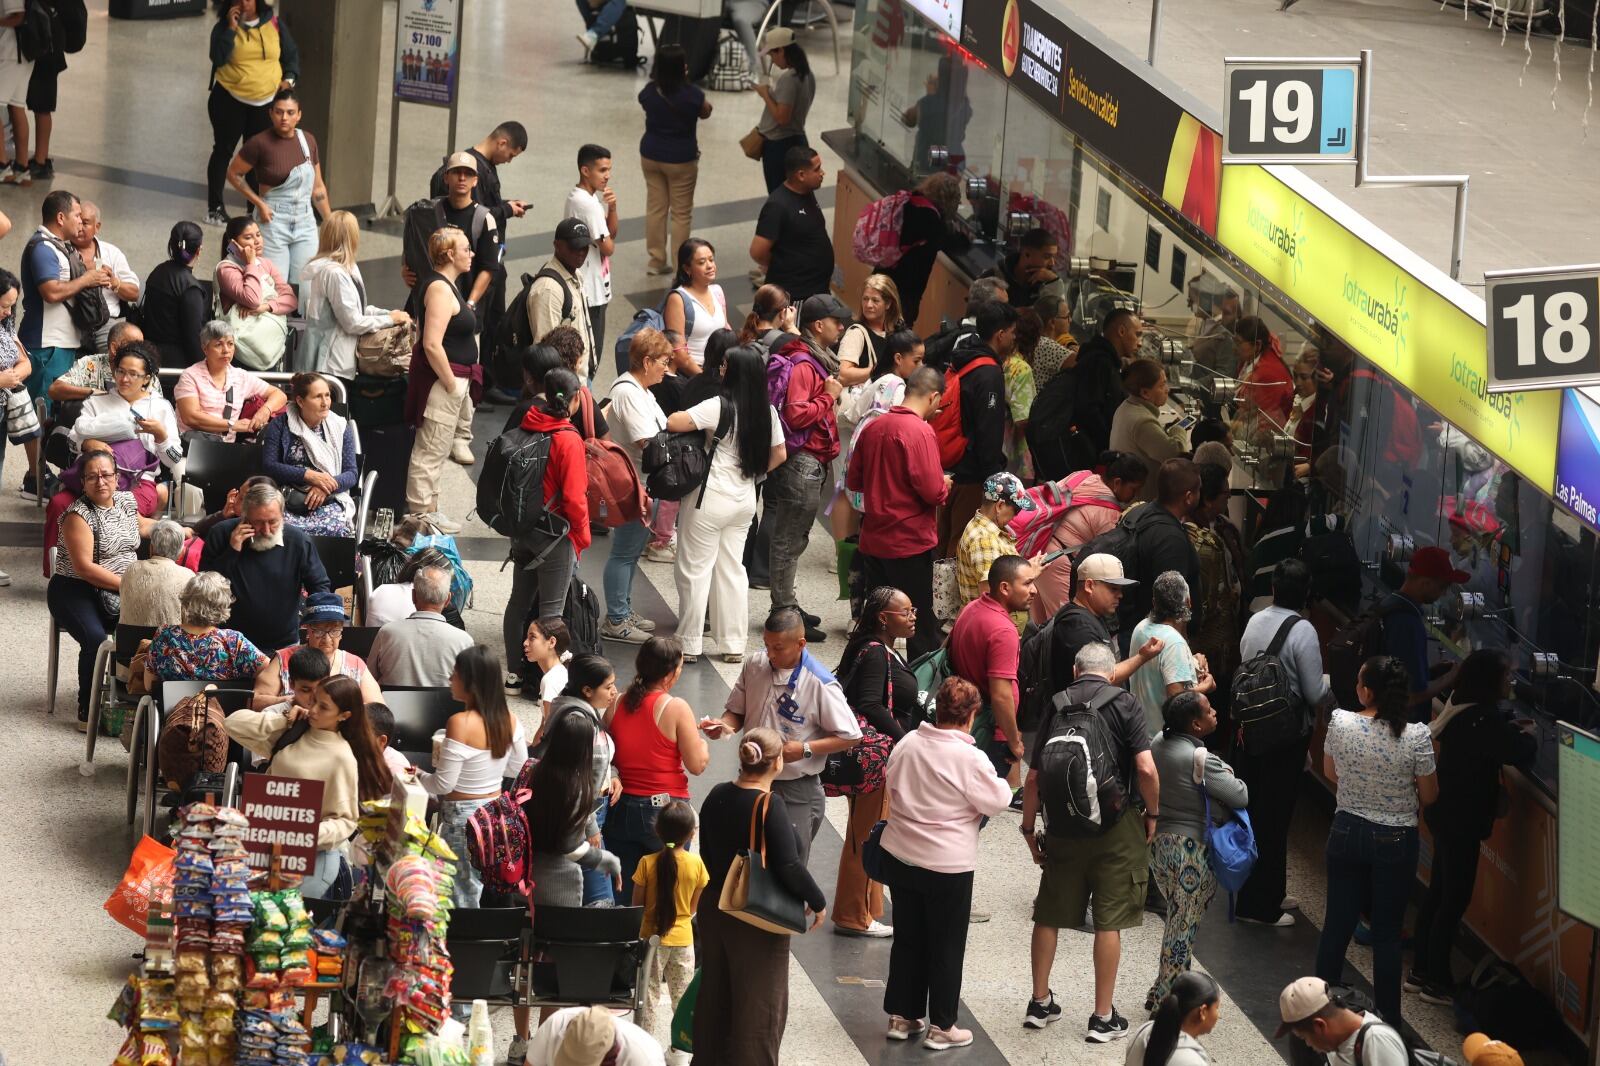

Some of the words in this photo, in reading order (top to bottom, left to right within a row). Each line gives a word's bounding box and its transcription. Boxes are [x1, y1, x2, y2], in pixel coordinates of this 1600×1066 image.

[412, 31, 442, 48] $7.100
[1023, 21, 1062, 72] TRANSPORTES
[1068, 66, 1089, 107] Servicio
[1088, 90, 1099, 115] con
[1098, 91, 1119, 128] calidad
[1239, 80, 1314, 144] 19
[1502, 291, 1591, 367] 18
[1555, 474, 1569, 504] Las
[1569, 485, 1597, 525] Palmas
[265, 780, 301, 798] CAFÉ
[244, 802, 316, 824] PAQUETES
[240, 827, 315, 848] RECARGAS
[246, 851, 308, 872] MINTOS
